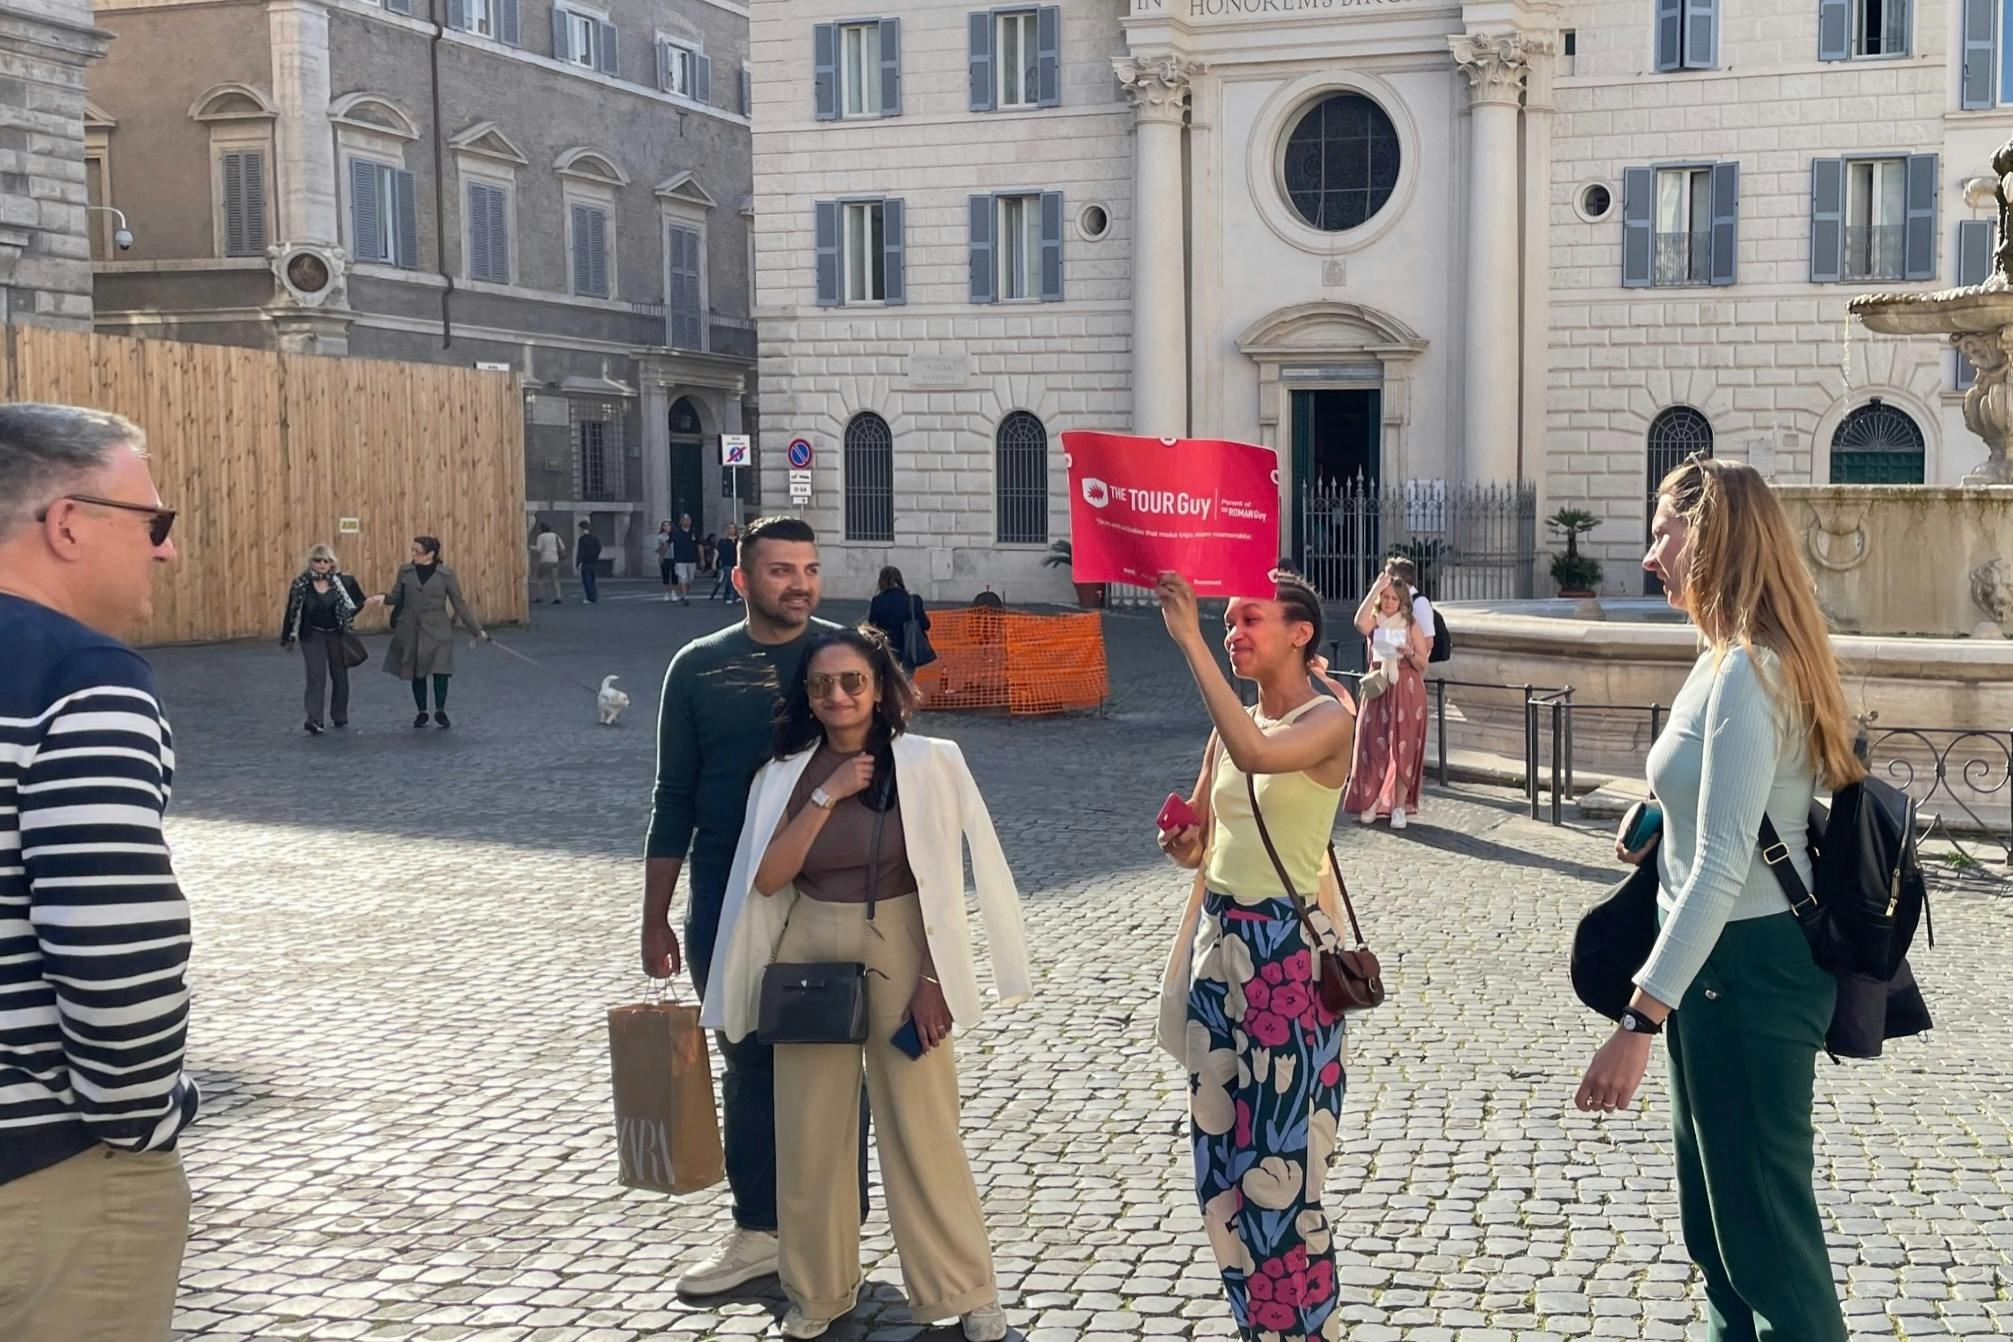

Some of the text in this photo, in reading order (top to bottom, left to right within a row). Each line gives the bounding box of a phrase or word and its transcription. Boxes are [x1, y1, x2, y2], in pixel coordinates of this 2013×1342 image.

[1109, 485, 1211, 520] THE TOUR Guy
[1228, 507, 1253, 519] ROMAN
